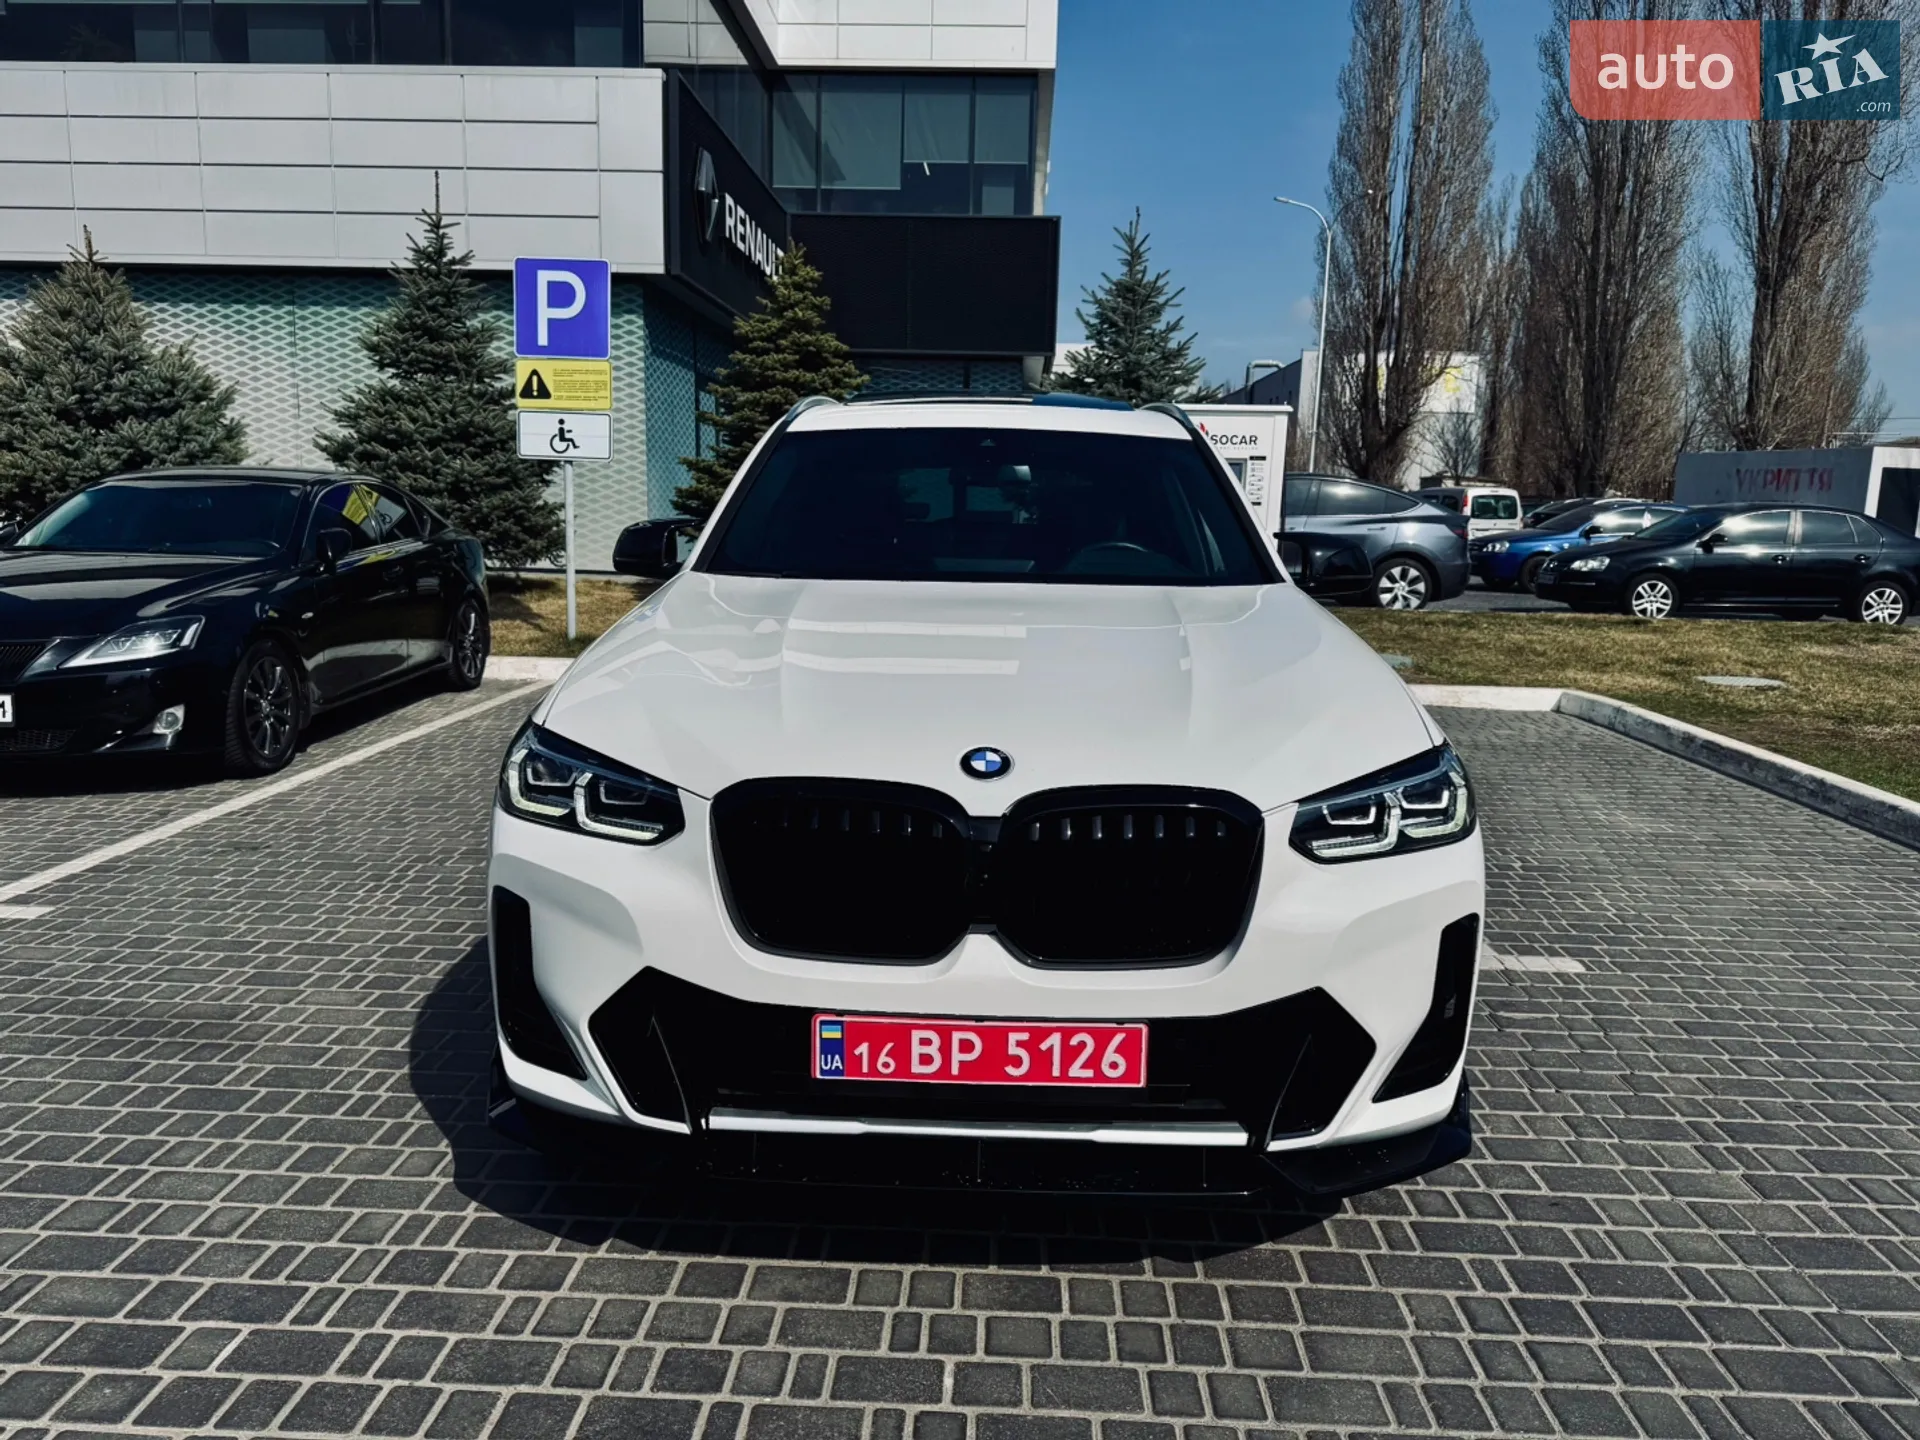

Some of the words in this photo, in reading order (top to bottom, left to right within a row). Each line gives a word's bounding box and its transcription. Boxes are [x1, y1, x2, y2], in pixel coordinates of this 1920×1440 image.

[537, 269, 586, 347] P
[1210, 434, 1258, 446] SOCAR
[821, 1054, 843, 1071] UA
[853, 1042, 896, 1074] 16
[910, 1030, 983, 1076] BP
[1003, 1031, 1127, 1079] 5126
